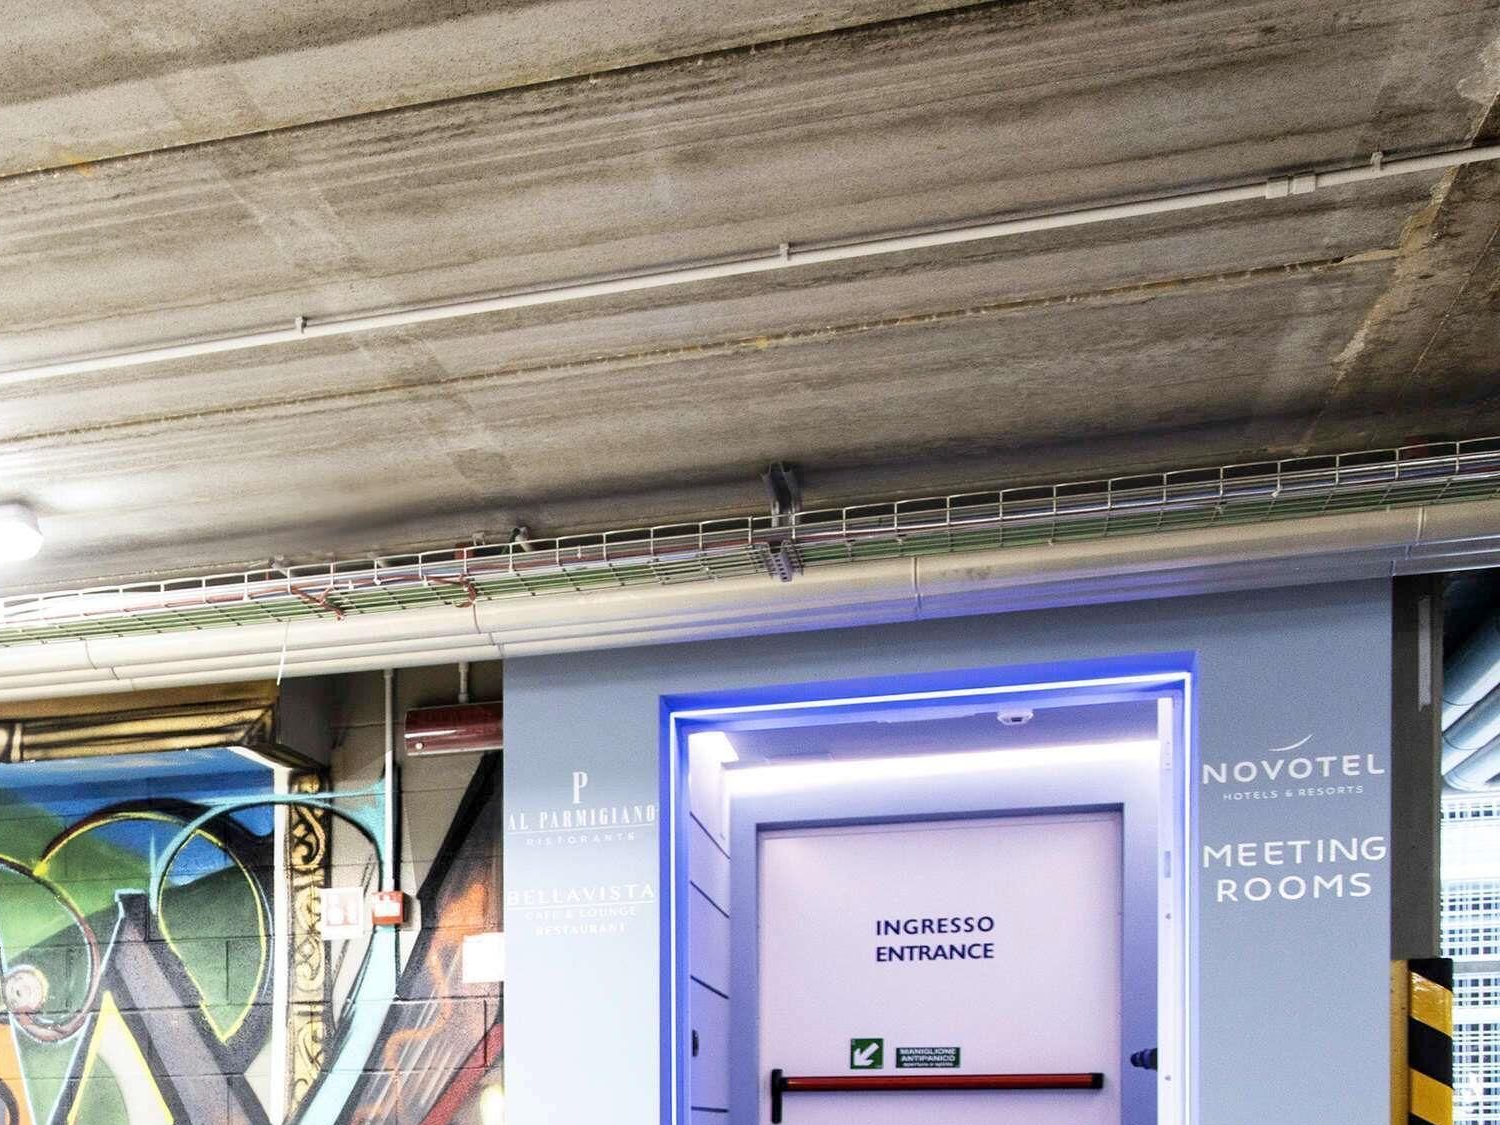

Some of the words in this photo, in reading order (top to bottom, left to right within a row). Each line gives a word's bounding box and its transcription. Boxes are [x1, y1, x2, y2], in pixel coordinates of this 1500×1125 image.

[1203, 754, 1385, 785] NOVOTEL
[571, 771, 589, 804] P
[1223, 789, 1278, 801] HOTELS
[1285, 789, 1293, 798] &
[1298, 785, 1364, 797] RESORTS
[507, 812, 529, 831] AL
[539, 804, 656, 829] PARMIGIANO
[1203, 836, 1387, 868] MEETING
[507, 883, 655, 906] BELLAVISTA
[1217, 872, 1372, 902] ROOMS
[579, 905, 637, 918] LOUNGE
[534, 922, 627, 936] RESTAURANT
[876, 916, 995, 936] INGRESSO
[876, 943, 995, 962] ENTRANCE
